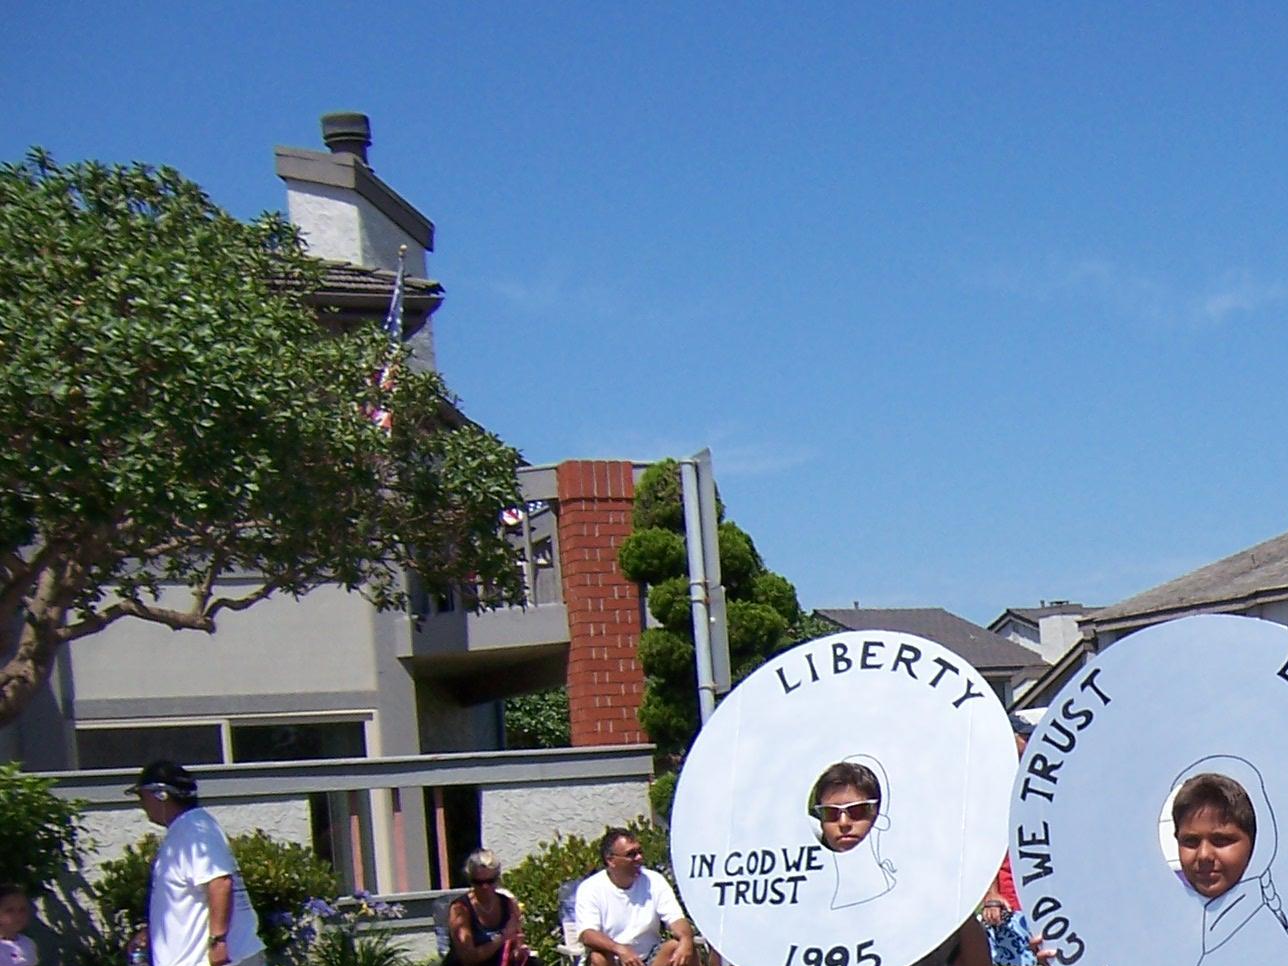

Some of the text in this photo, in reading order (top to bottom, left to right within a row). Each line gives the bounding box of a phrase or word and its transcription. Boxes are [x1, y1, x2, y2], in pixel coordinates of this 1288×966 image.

[776, 641, 985, 709] LIBERTY
[1020, 668, 1113, 803] TRUST
[689, 846, 823, 878] IN GOD WE
[1018, 820, 1054, 887] WE
[713, 875, 807, 906] TRUST
[1031, 895, 1086, 966] GOD
